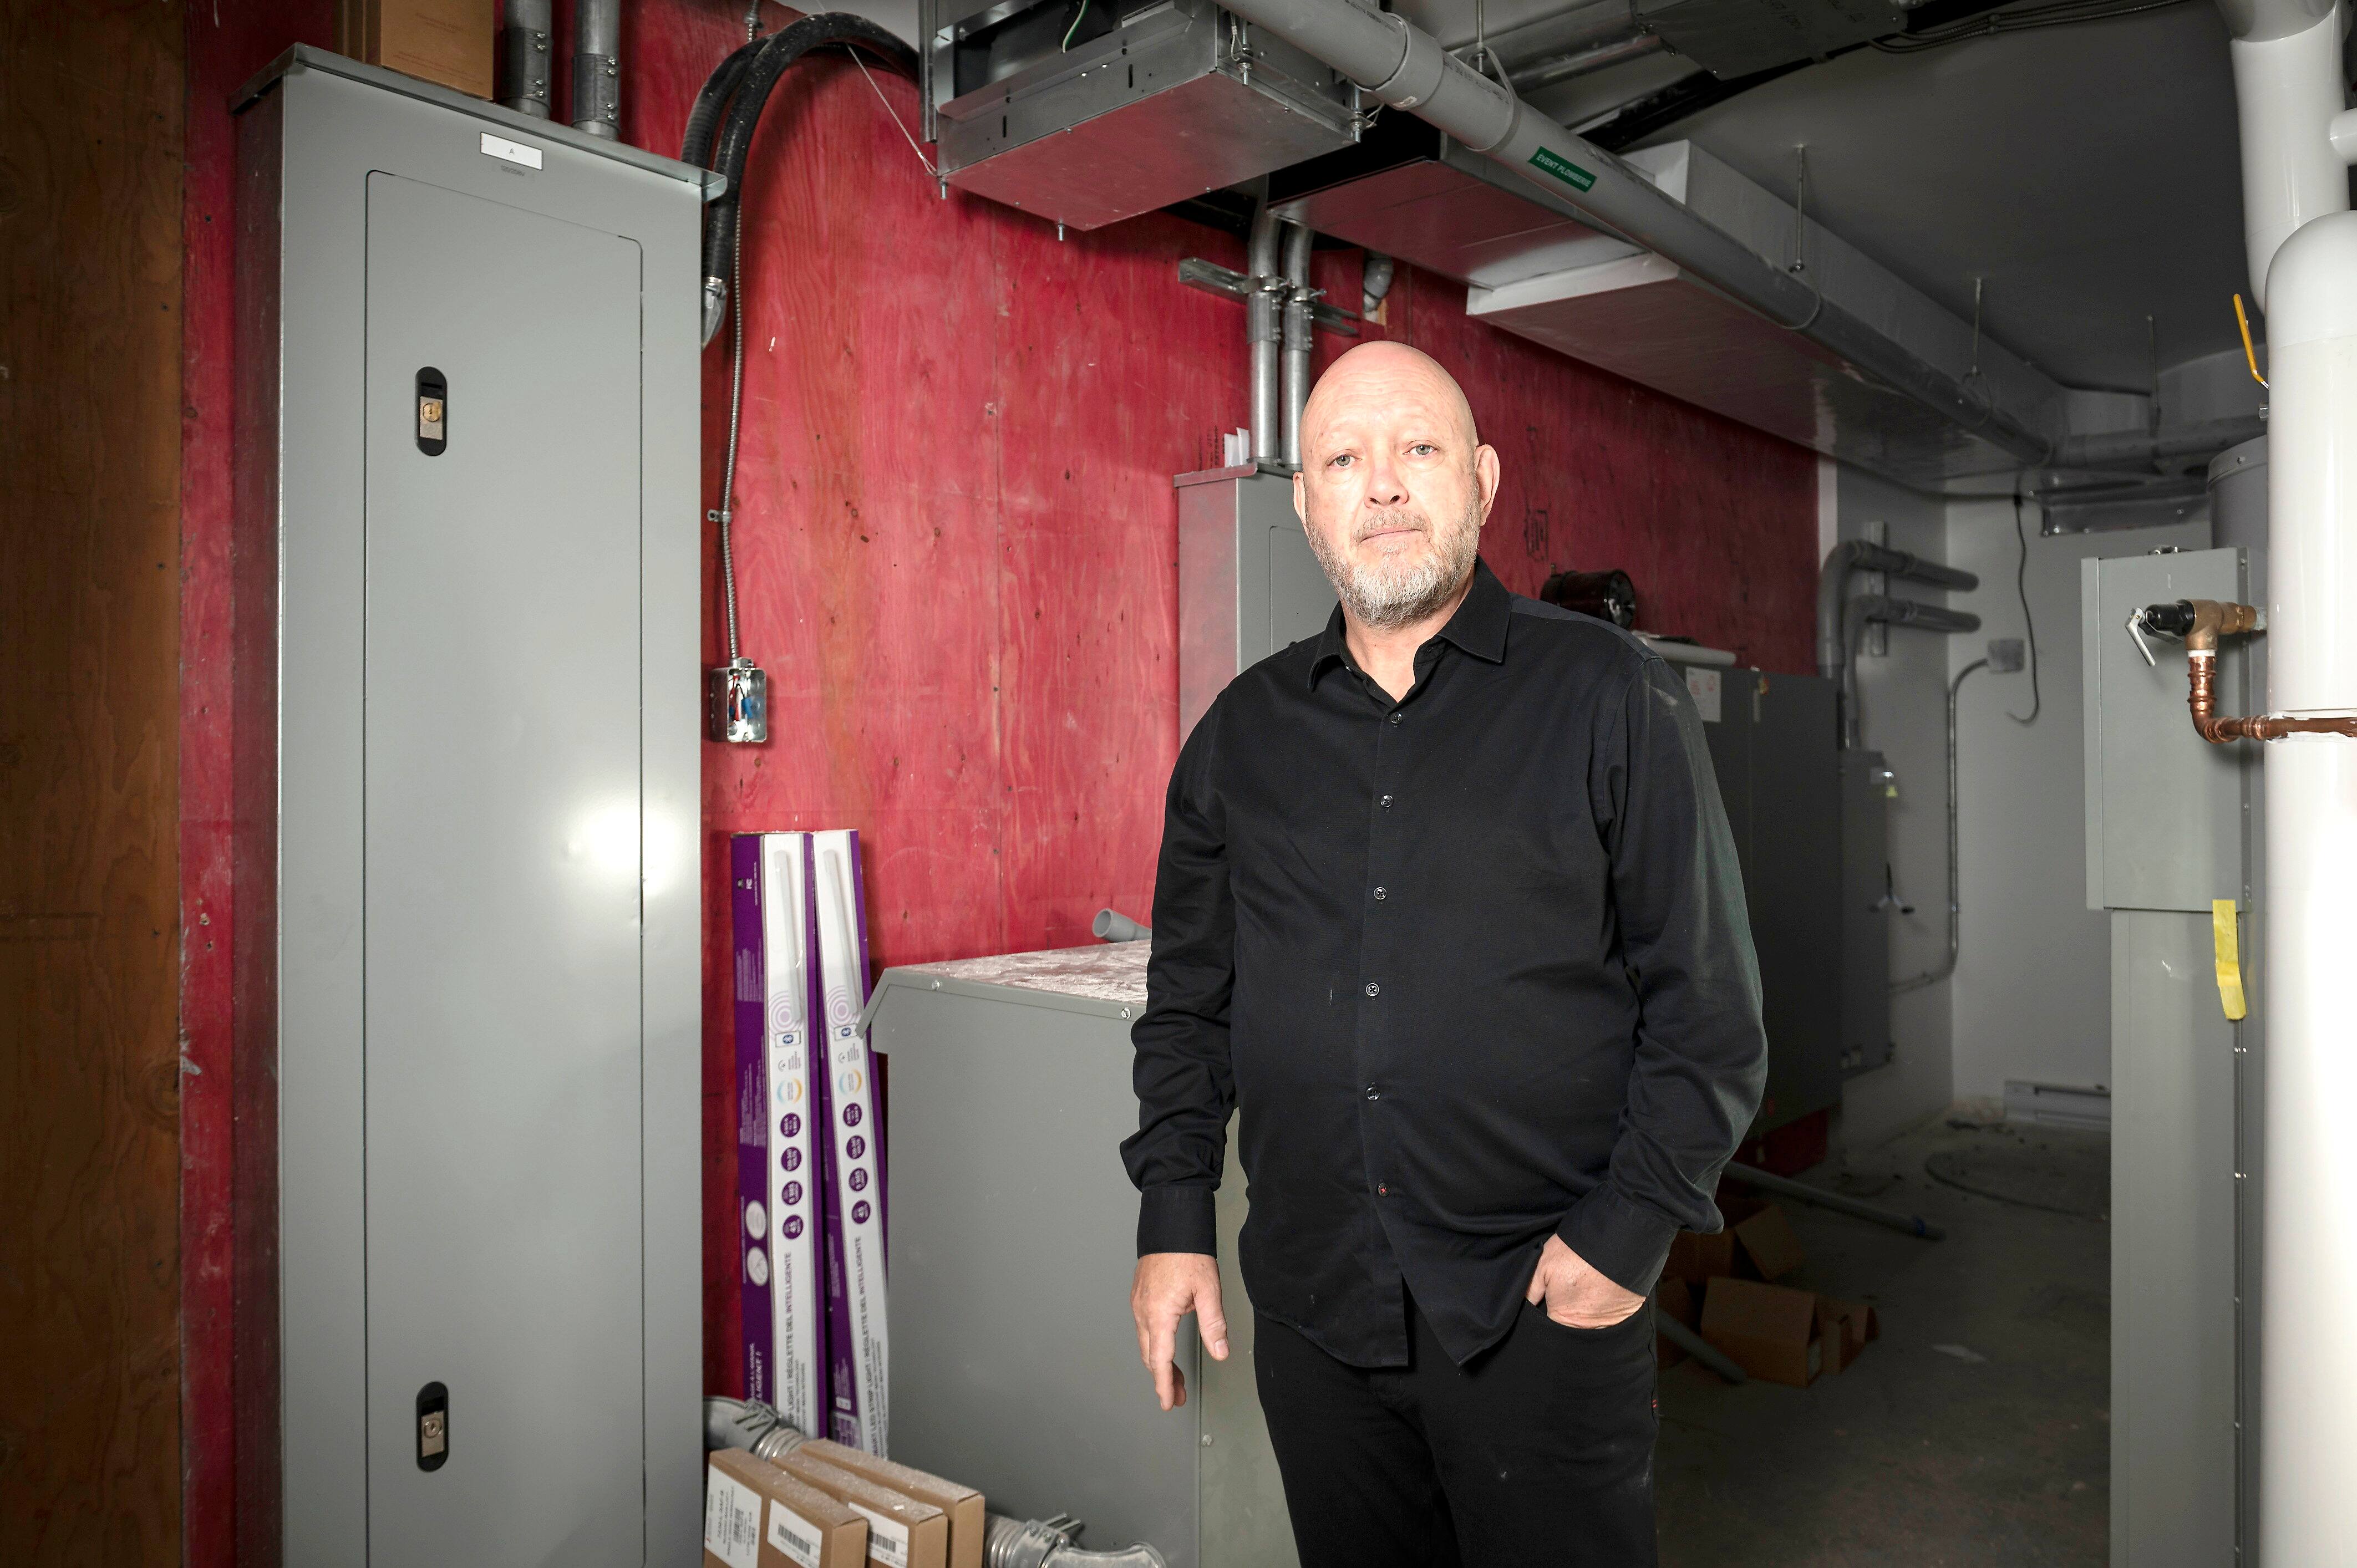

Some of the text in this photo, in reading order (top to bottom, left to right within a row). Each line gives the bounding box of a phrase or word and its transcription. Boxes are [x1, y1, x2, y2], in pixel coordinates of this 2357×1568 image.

[1558, 165, 1592, 187] PLOMBERIE
[784, 1251, 793, 1314] INTELLIGENTE
[855, 1236, 865, 1295] INTELLIGENTE
[786, 1385, 795, 1412] LIGHT
